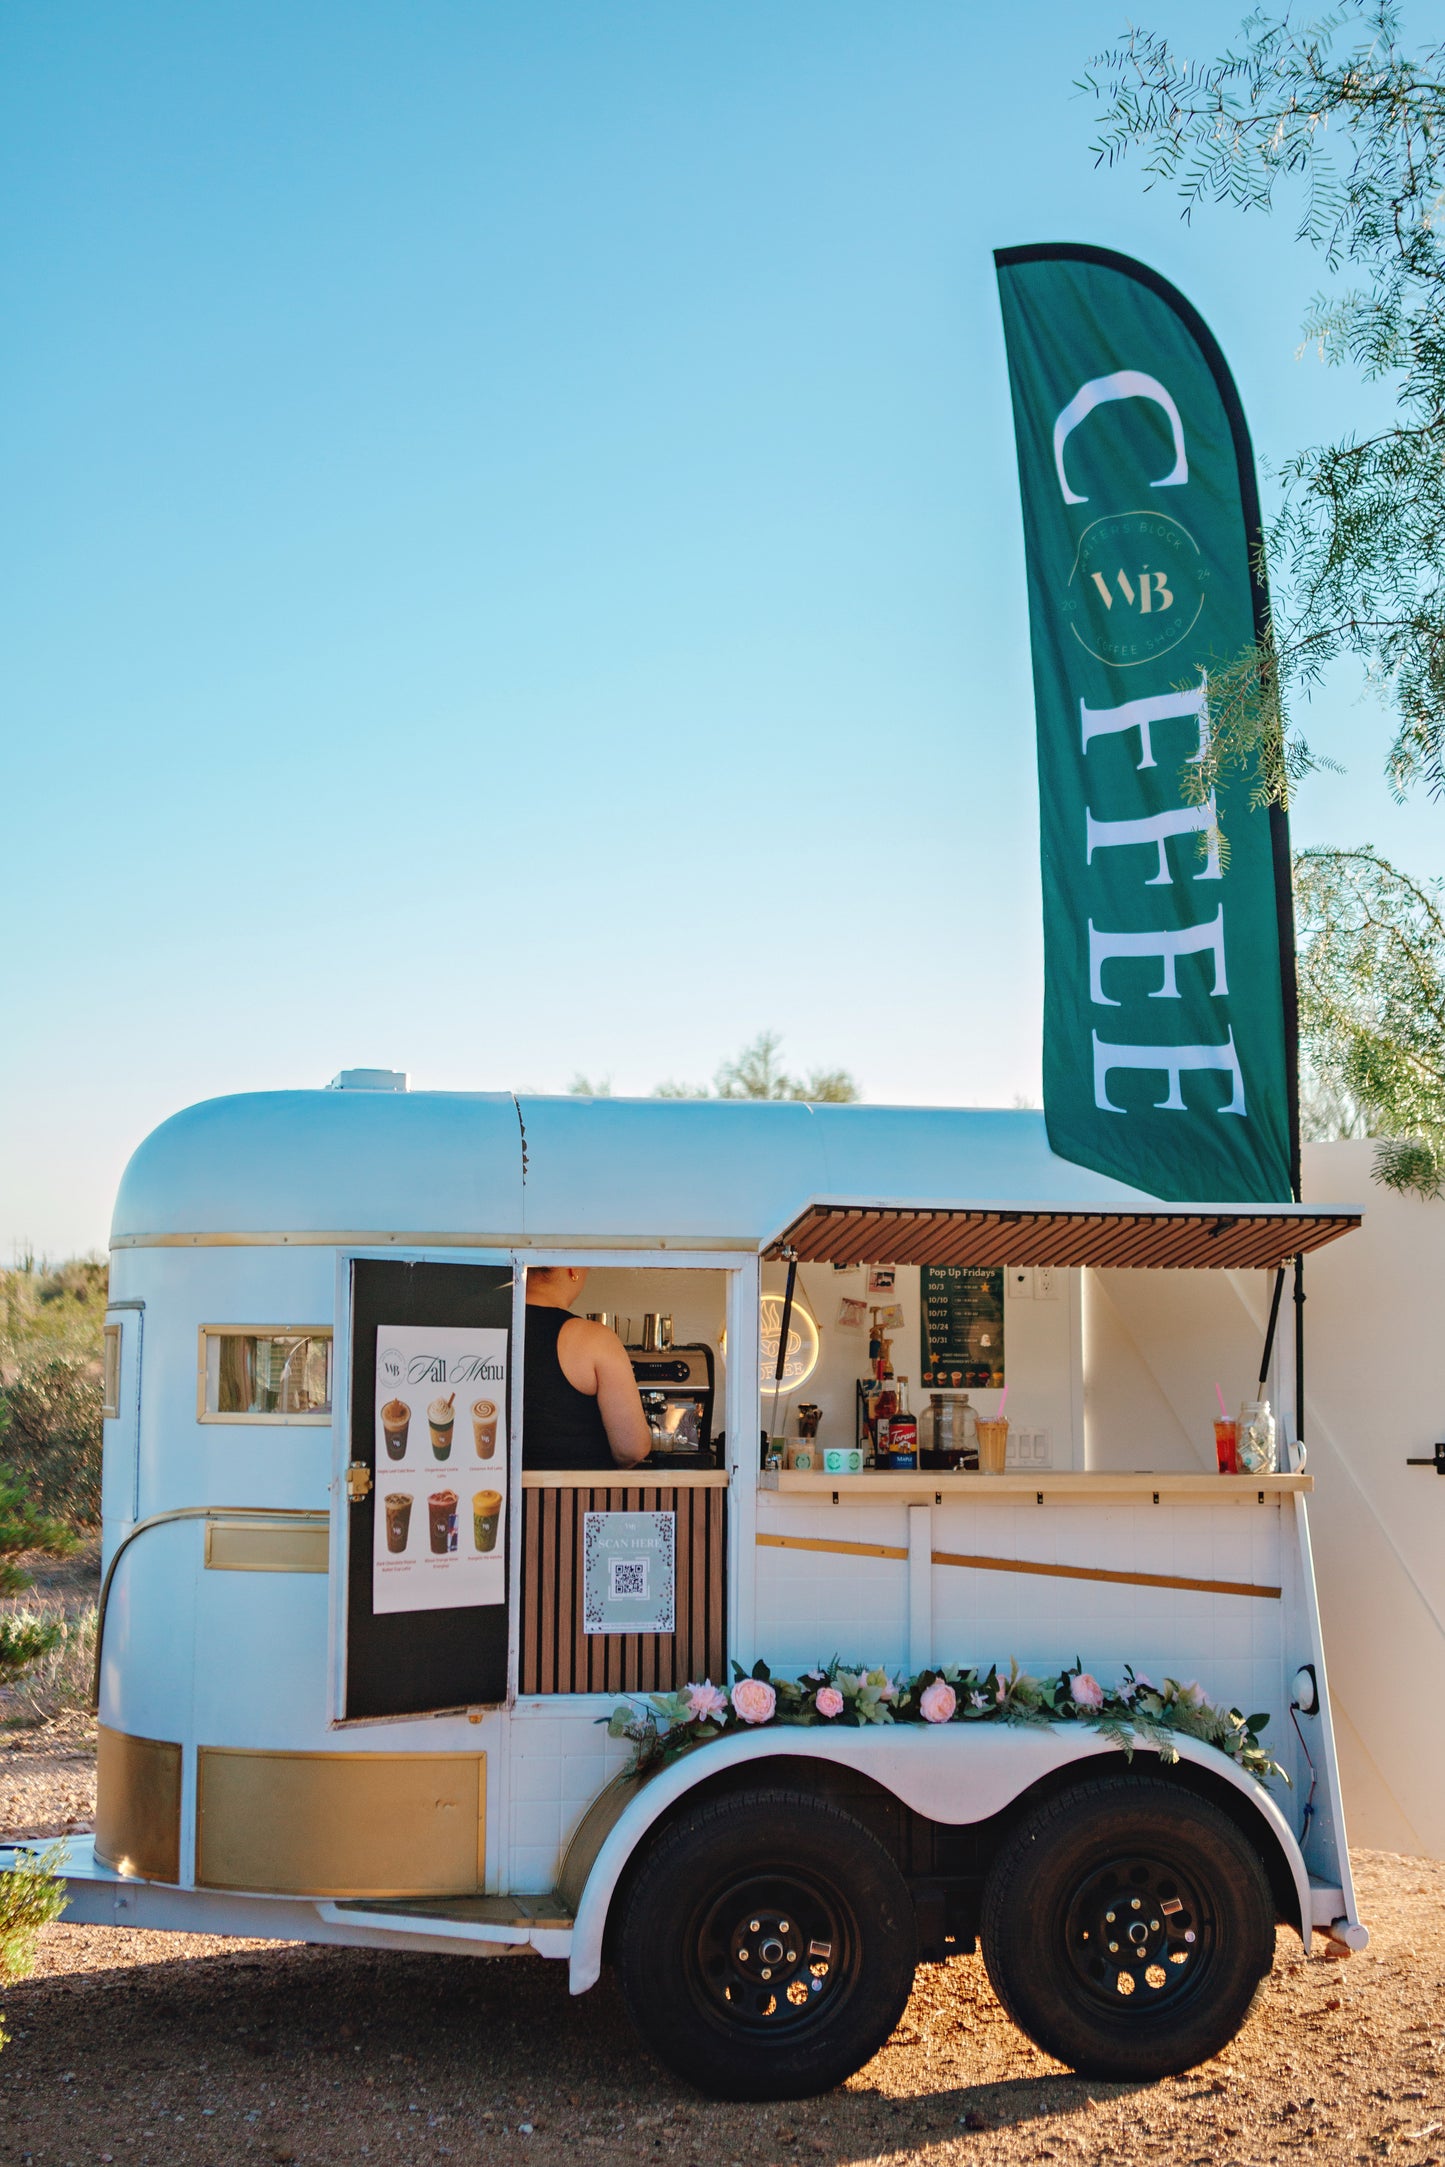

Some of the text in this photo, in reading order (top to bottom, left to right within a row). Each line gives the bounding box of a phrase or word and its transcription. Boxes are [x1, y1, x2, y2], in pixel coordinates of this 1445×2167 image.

[1139, 521, 1182, 551] BLOCK
[1090, 564, 1174, 614] WB
[1146, 618, 1183, 649] SHOP
[929, 1267, 996, 1279] Pop Up Fridays
[928, 1283, 944, 1291] 10/3
[928, 1296, 948, 1304] 10/10
[928, 1323, 949, 1331] 10/24
[928, 1336, 948, 1344] 10/31
[384, 1362, 400, 1377] WB
[407, 1354, 504, 1385] Fall Menu
[598, 1538, 662, 1549] SCAN HERE
